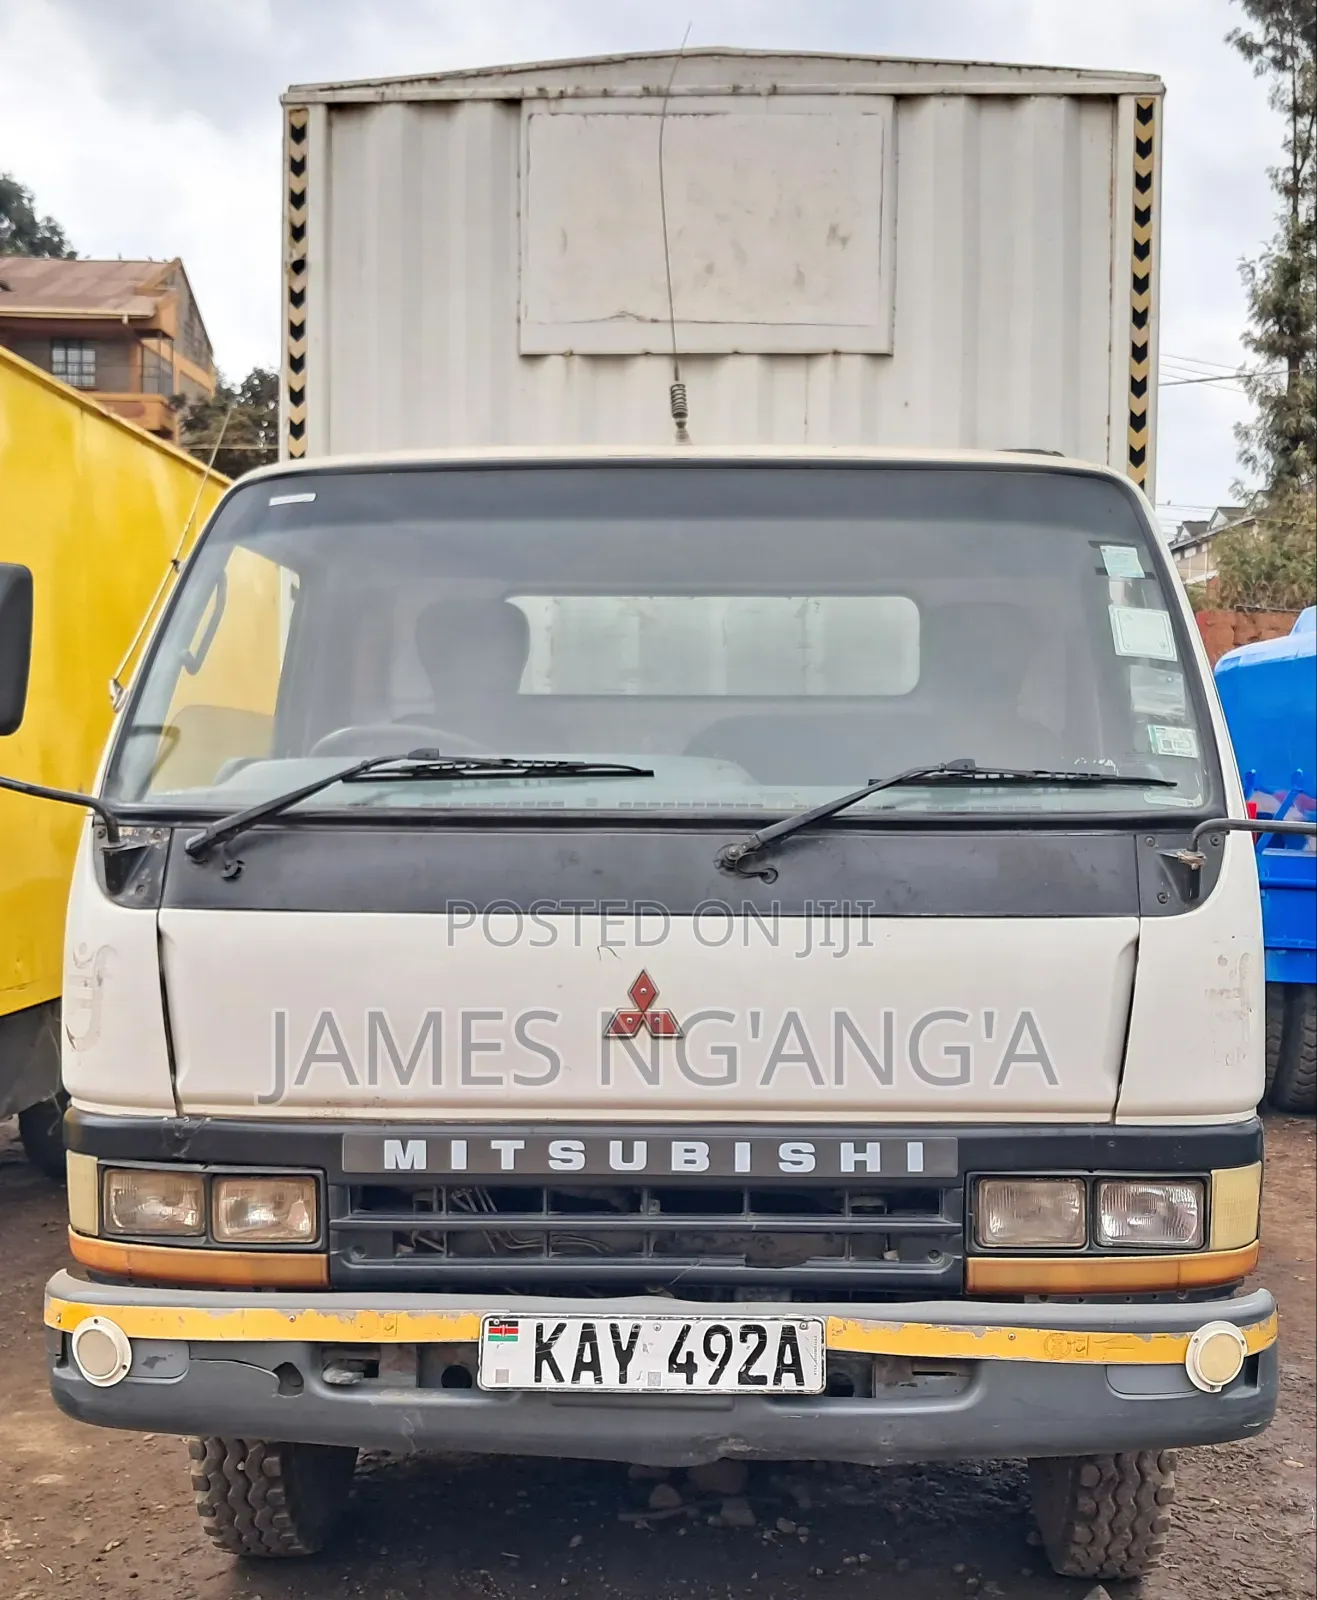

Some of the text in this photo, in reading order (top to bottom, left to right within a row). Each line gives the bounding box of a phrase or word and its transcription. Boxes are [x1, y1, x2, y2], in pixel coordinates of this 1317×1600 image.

[382, 1139, 925, 1173] MITSUBISHI
[534, 1322, 642, 1385] KAY
[666, 1323, 806, 1387] 492A
